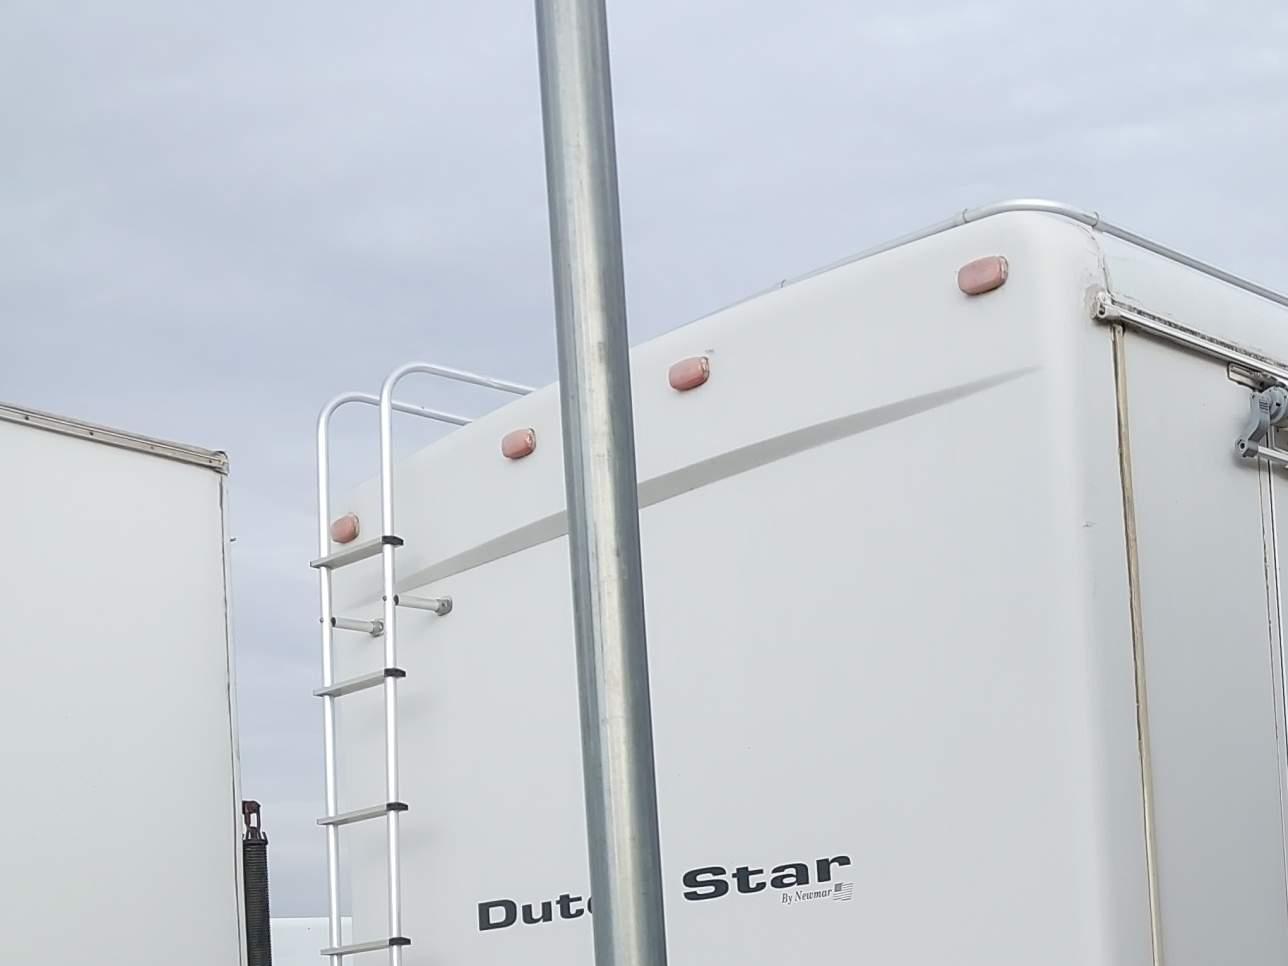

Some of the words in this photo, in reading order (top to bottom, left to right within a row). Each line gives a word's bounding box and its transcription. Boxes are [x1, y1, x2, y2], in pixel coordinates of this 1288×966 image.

[477, 893, 593, 932] Dut
[682, 855, 851, 901] Star
[782, 892, 792, 904] By
[794, 889, 832, 902] Newmar
